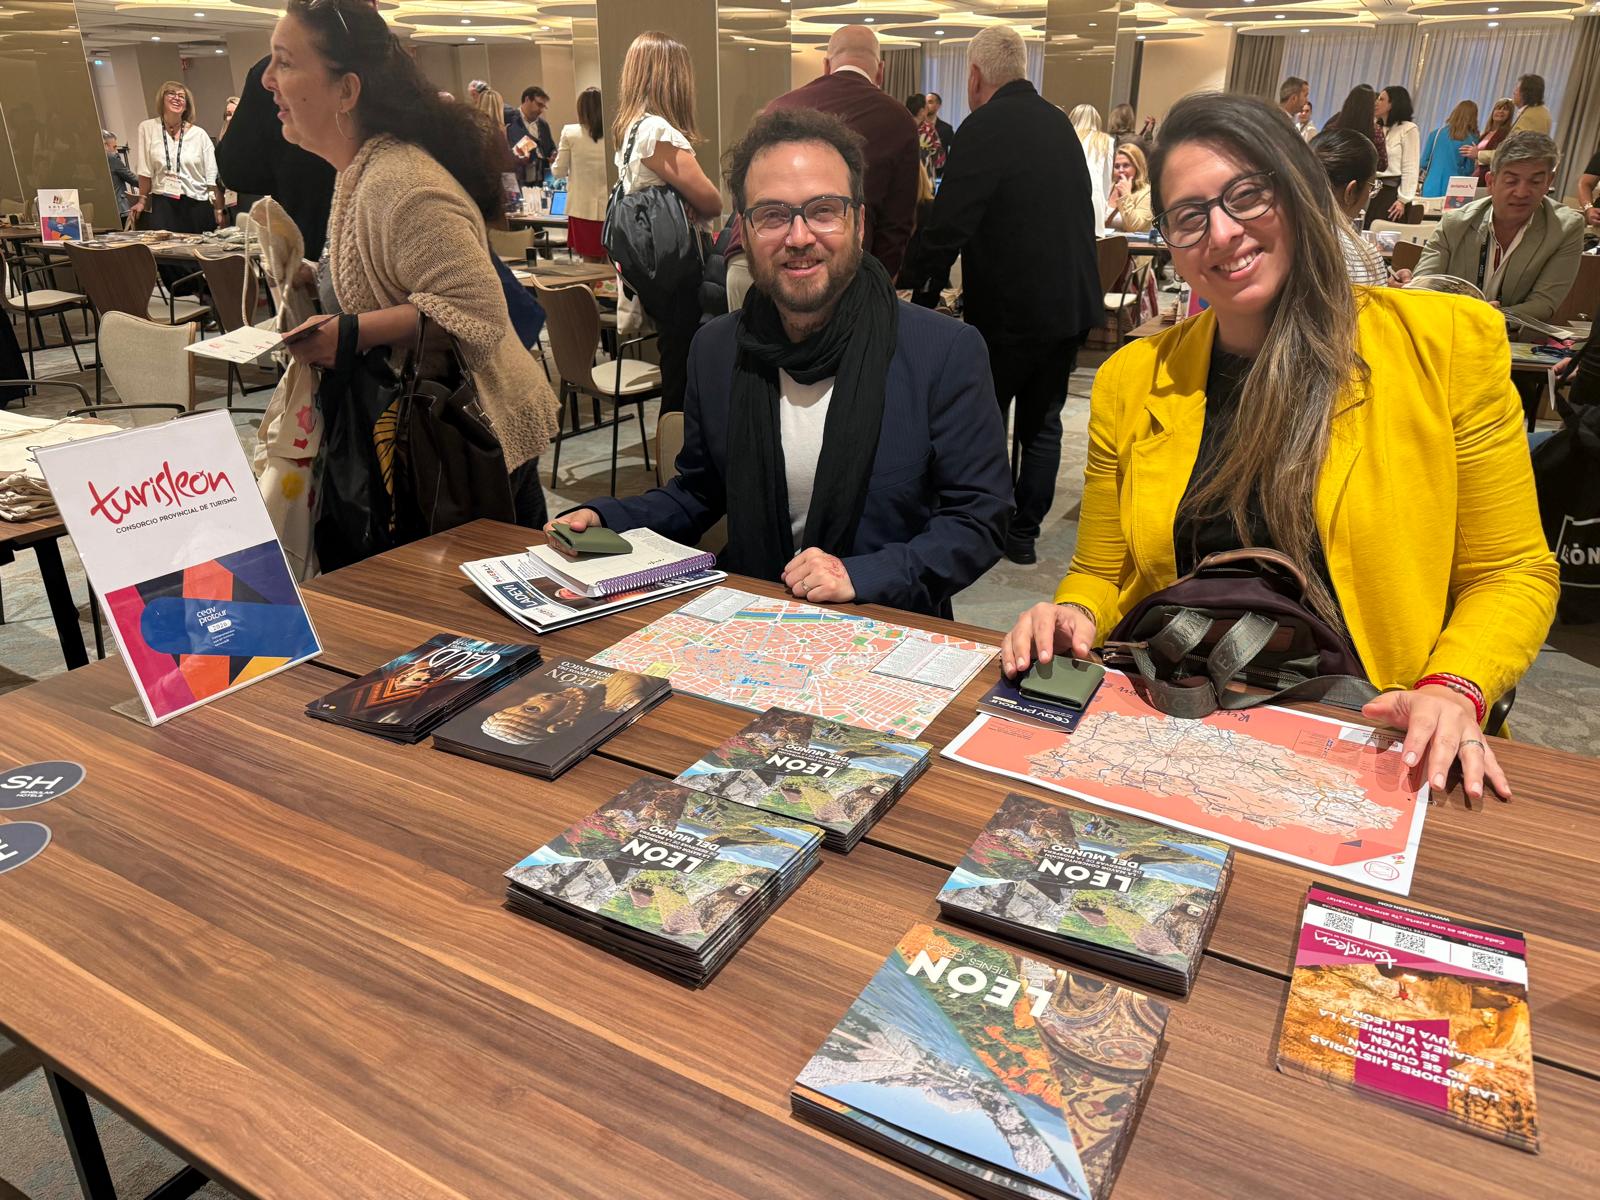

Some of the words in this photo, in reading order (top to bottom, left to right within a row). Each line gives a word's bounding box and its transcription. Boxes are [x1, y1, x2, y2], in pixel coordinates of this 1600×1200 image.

[115, 517, 158, 534] CONSORCIO
[159, 507, 199, 523] PROVINCIAL
[199, 503, 209, 512] DE
[209, 496, 238, 508] TURISMO
[196, 606, 216, 618] ceav
[198, 609, 227, 627] protour
[544, 668, 601, 689] LEÓN
[990, 699, 1037, 716] protour
[1037, 711, 1070, 724] ceav
[784, 744, 827, 757] MUNDO
[827, 753, 849, 762] DEL
[765, 753, 838, 778] LEÓN
[0, 775, 64, 790] SH
[648, 825, 695, 842] MUNDO
[695, 839, 720, 851] DEL
[1051, 844, 1106, 862] MUNDO
[620, 838, 703, 875] LEÓN
[1112, 857, 1140, 869] DEL
[1037, 858, 1132, 893] LEÓN
[1377, 900, 1450, 922] WWW.TURISLEON.COM
[1404, 916, 1431, 927] puerta.
[1457, 929, 1484, 941] código
[1484, 936, 1506, 946] Cada
[968, 957, 1010, 977] TIENES
[905, 949, 1053, 1018] LEÓN
[1319, 1008, 1336, 1019] LA
[1341, 1015, 1405, 1042] EMPIEZA
[1395, 1024, 1417, 1034] EN
[1310, 1034, 1389, 1067] HISTORIAS
[1367, 1033, 1417, 1057] VIVEN.
[1406, 1037, 1418, 1047] Y
[1420, 1051, 1440, 1063] SE
[1421, 1042, 1495, 1069] ESCANEA
[1422, 1062, 1442, 1074] SE
[1445, 1068, 1470, 1082] NO
[1392, 1063, 1465, 1091] MEJORES
[1469, 1085, 1500, 1102] LAS
